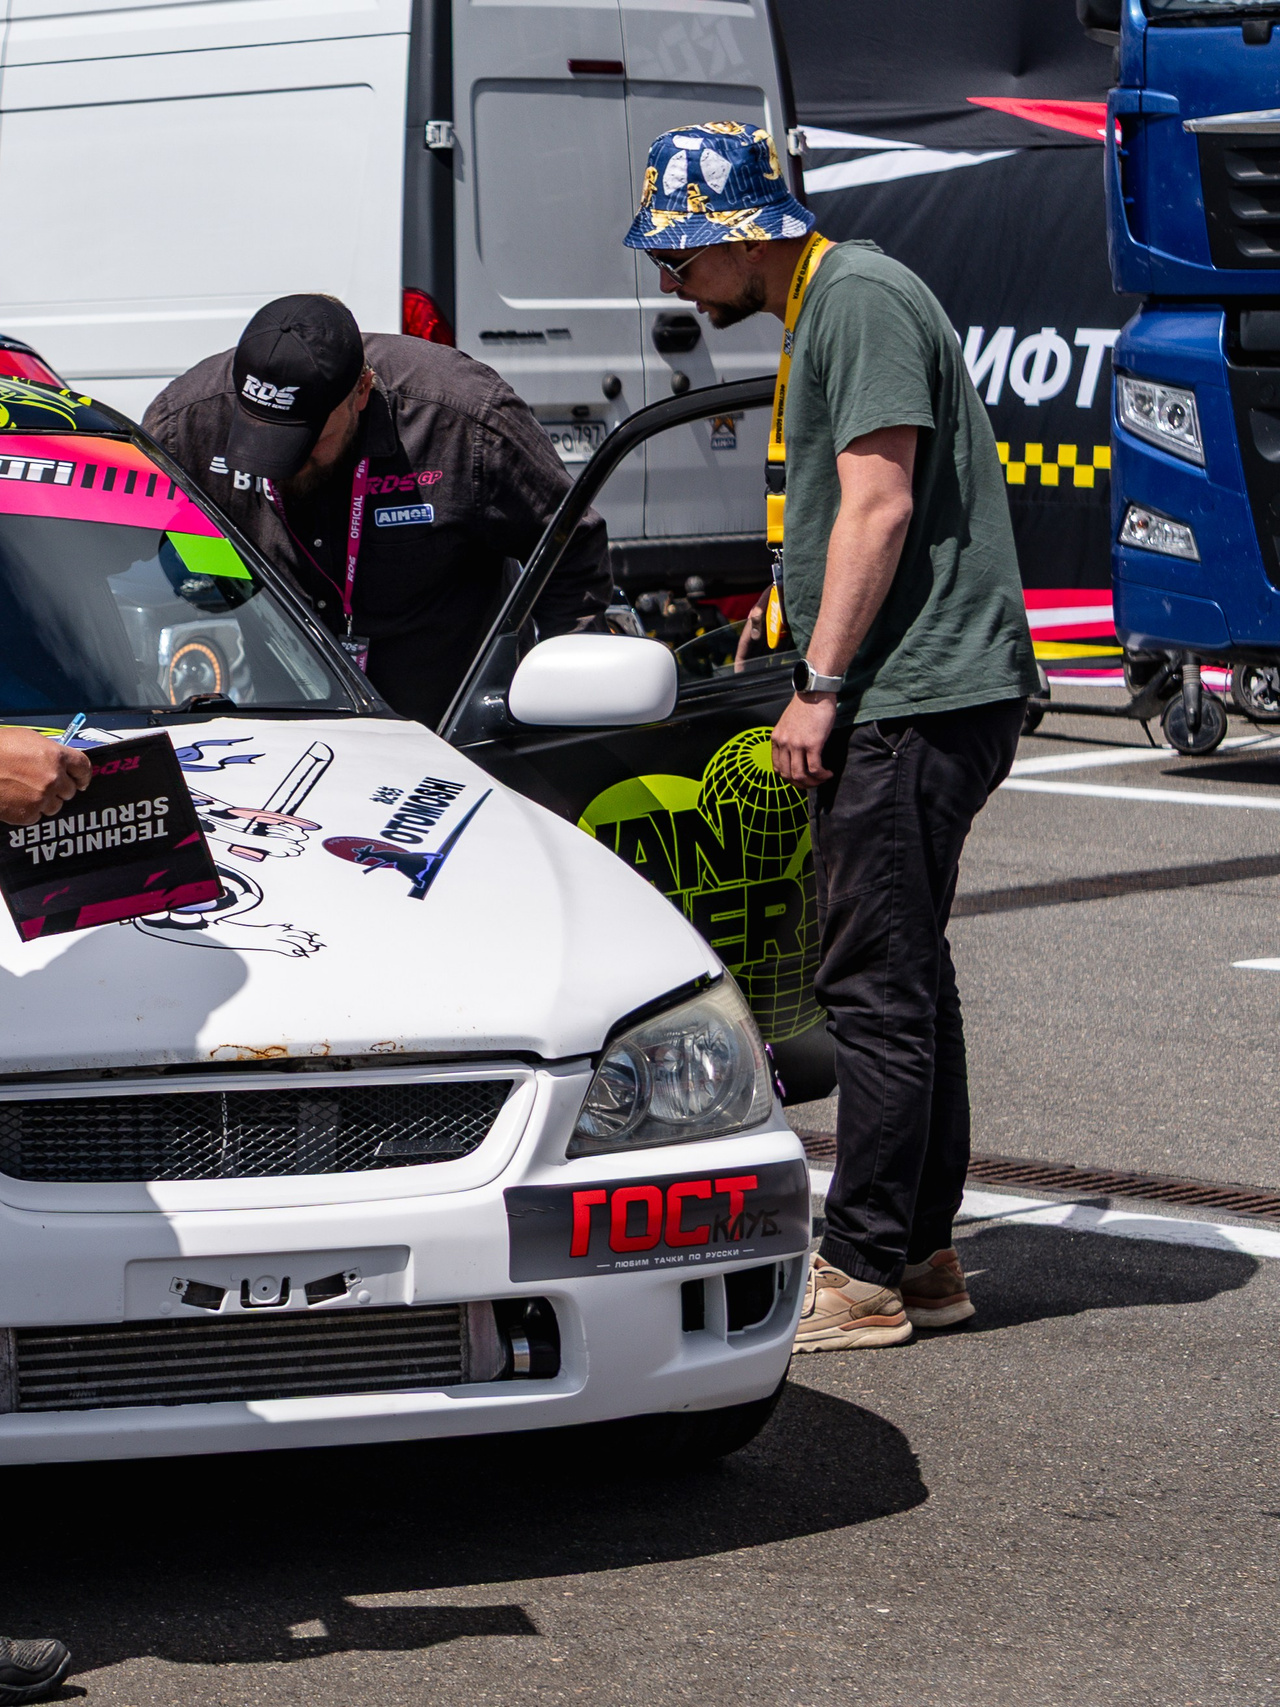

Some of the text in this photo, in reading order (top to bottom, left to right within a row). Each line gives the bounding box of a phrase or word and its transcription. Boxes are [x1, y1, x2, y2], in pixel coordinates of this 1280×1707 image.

[242, 373, 300, 405] RDS
[954, 326, 1122, 408] ИФТ
[418, 470, 443, 486] GP
[350, 495, 363, 539] OFFICIAL
[378, 508, 432, 524] AIMOL
[347, 555, 356, 582] RDS
[8, 796, 170, 848] SCRUTINEER
[379, 776, 467, 844] OTOMOSHI
[25, 818, 169, 865] TECHNICAL
[570, 1174, 758, 1258] ГОСТ
[614, 1248, 740, 1269] ЛЮБИМ ТАЧКИ ПО РУССКИ
